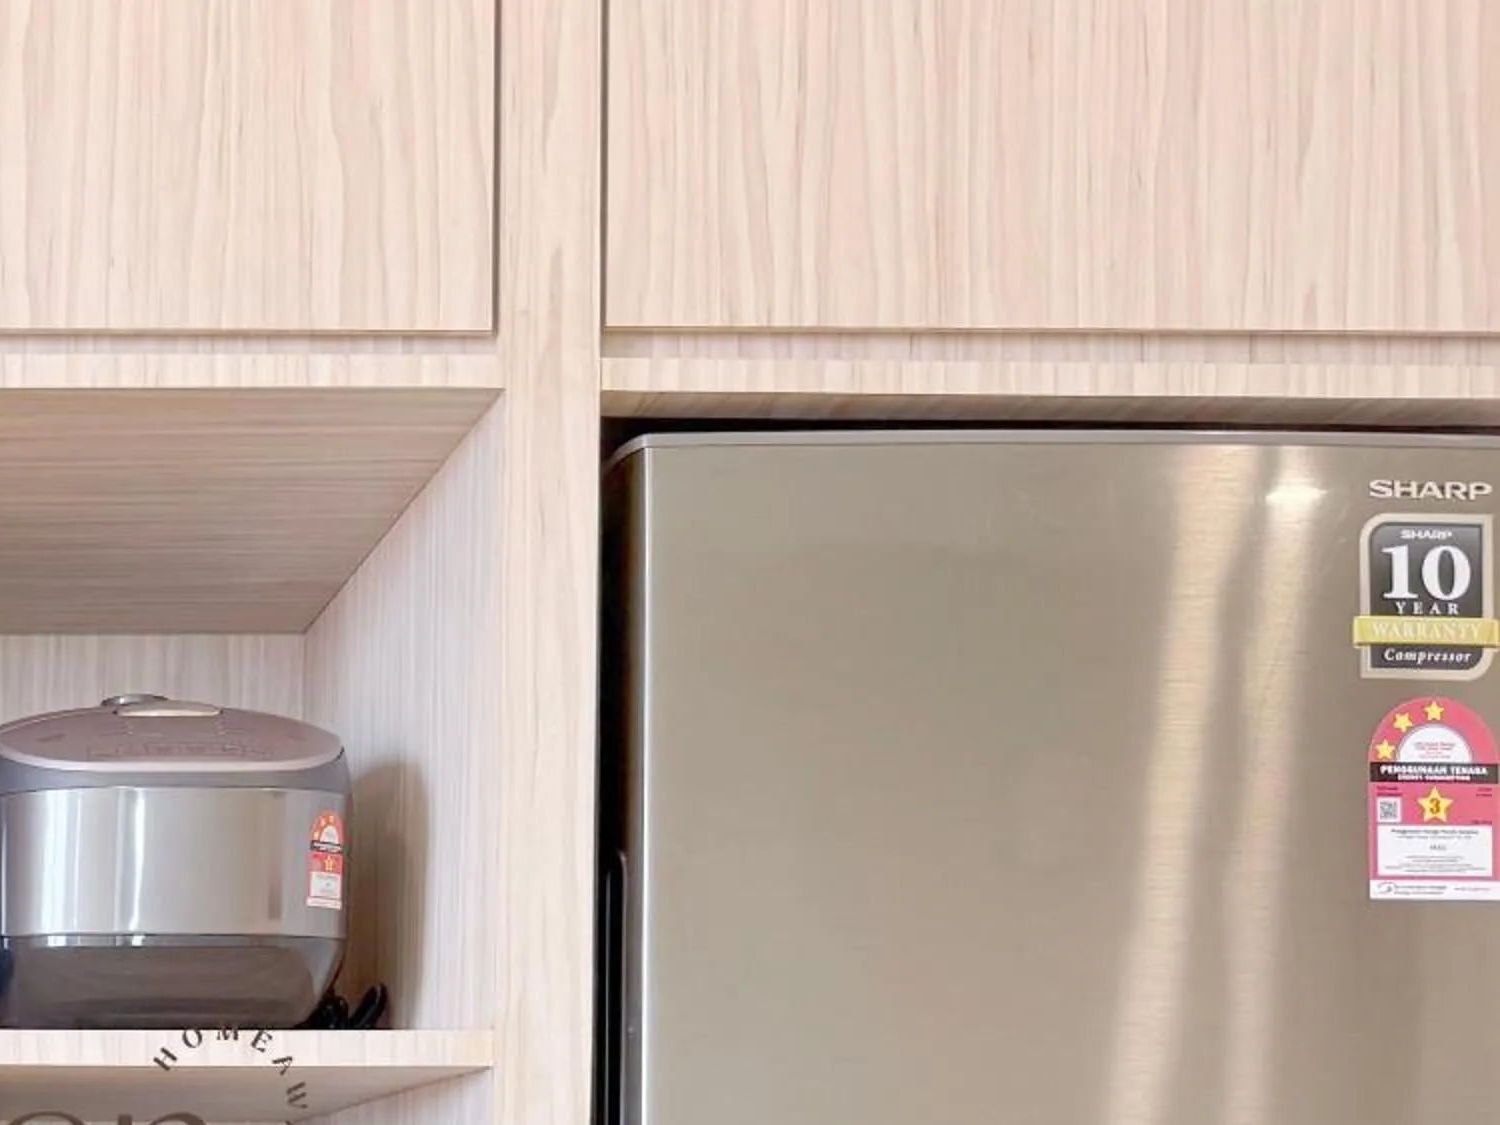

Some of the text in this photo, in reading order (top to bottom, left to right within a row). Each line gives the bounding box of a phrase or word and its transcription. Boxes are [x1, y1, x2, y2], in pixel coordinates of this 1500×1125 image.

[1368, 479, 1493, 500] SHARP
[1381, 544, 1471, 600] 10
[1395, 601, 1460, 615] YEAR
[1372, 621, 1481, 640] WARRANTY
[1383, 647, 1472, 665] Compressor
[1428, 798, 1442, 816] 3
